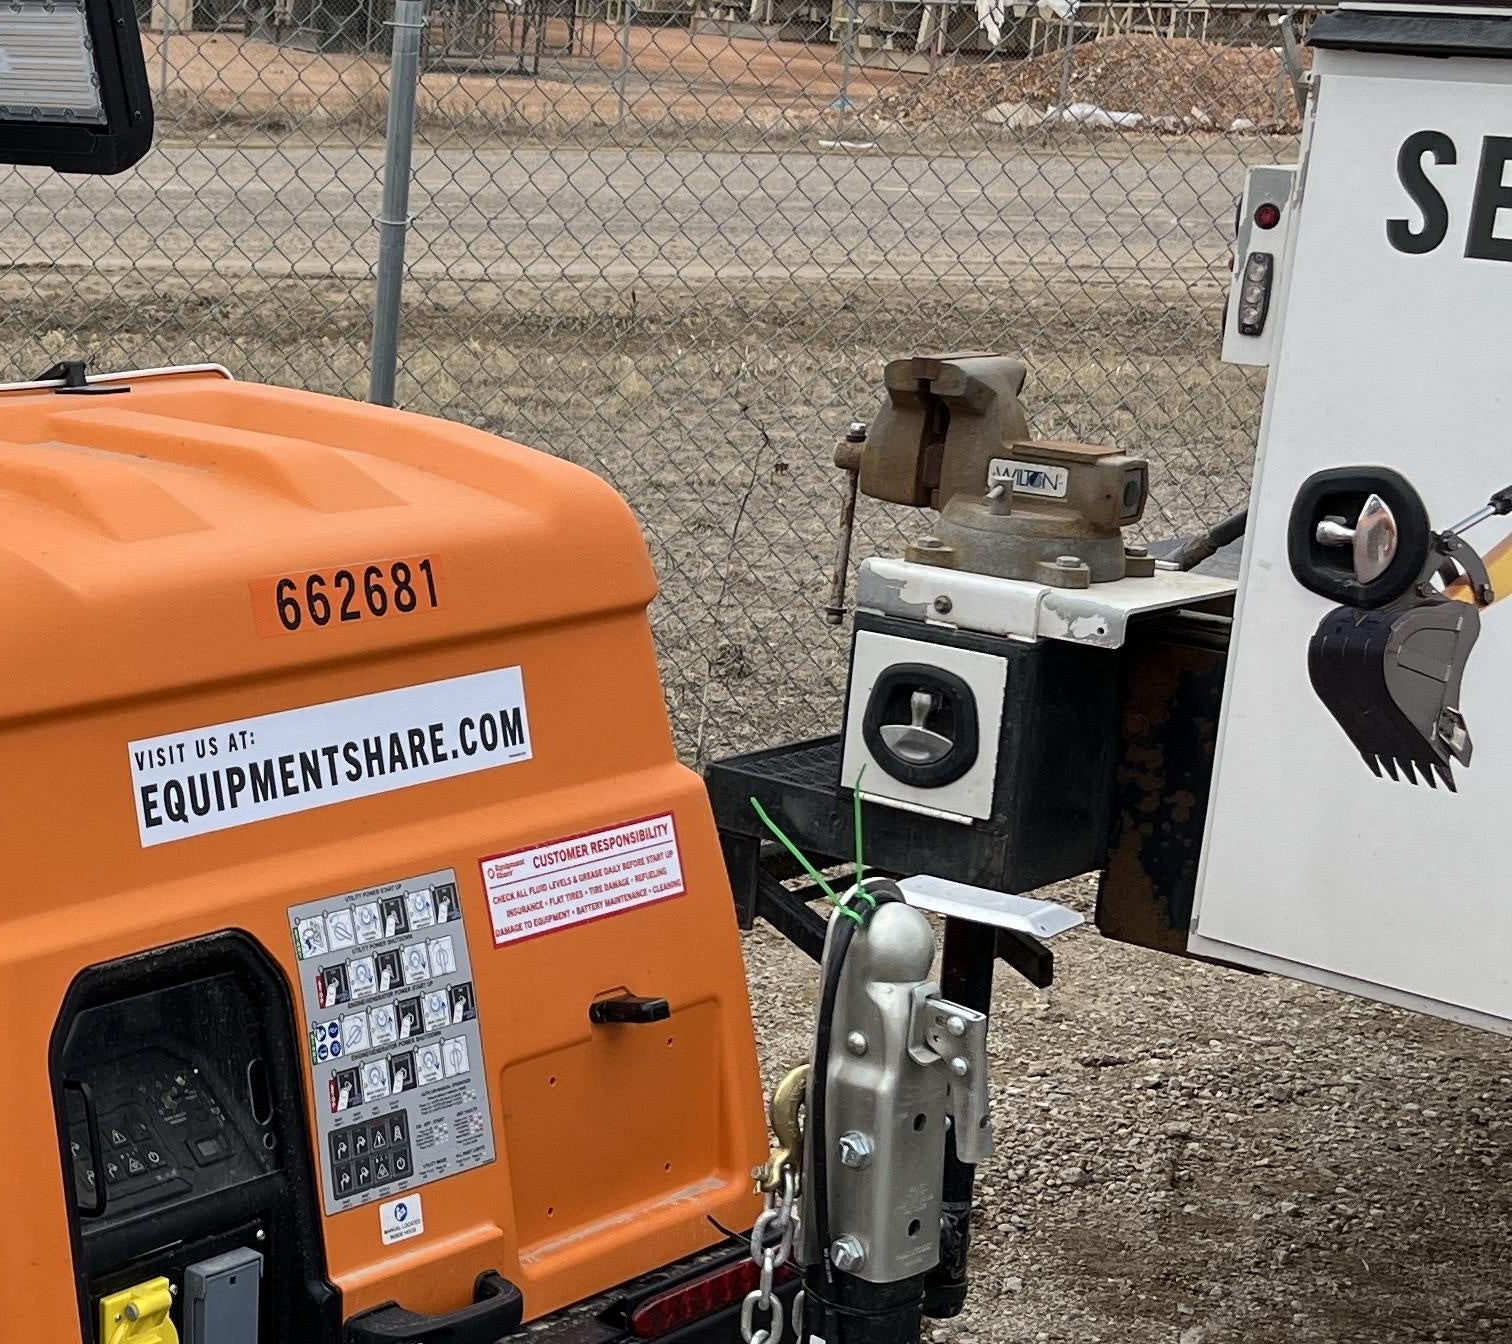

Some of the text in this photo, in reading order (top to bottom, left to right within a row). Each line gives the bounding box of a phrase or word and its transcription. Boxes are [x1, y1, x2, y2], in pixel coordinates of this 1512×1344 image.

[275, 558, 440, 632] 662681
[133, 730, 256, 772] VISIT US AT:
[140, 707, 526, 829] EQUIPMENTSHARE.COM
[532, 822, 669, 869] CUSTOMER RESPONSIBILITY
[492, 892, 515, 905] CHECK
[516, 889, 529, 899] ALL
[529, 884, 548, 897] FLUID
[548, 877, 572, 892] LEVELS
[578, 870, 603, 883] GREASE
[603, 865, 622, 877] DAILY
[622, 859, 645, 872] BEFORE
[646, 854, 665, 866] START
[666, 850, 674, 859] UP
[506, 868, 668, 918] INSURANCE FLAT TIRES TIRE DAMAGE REFUELING
[495, 879, 682, 938] DAMAGE TO EQUIPMENT BATTERY MAINTENANCE CLEANING
